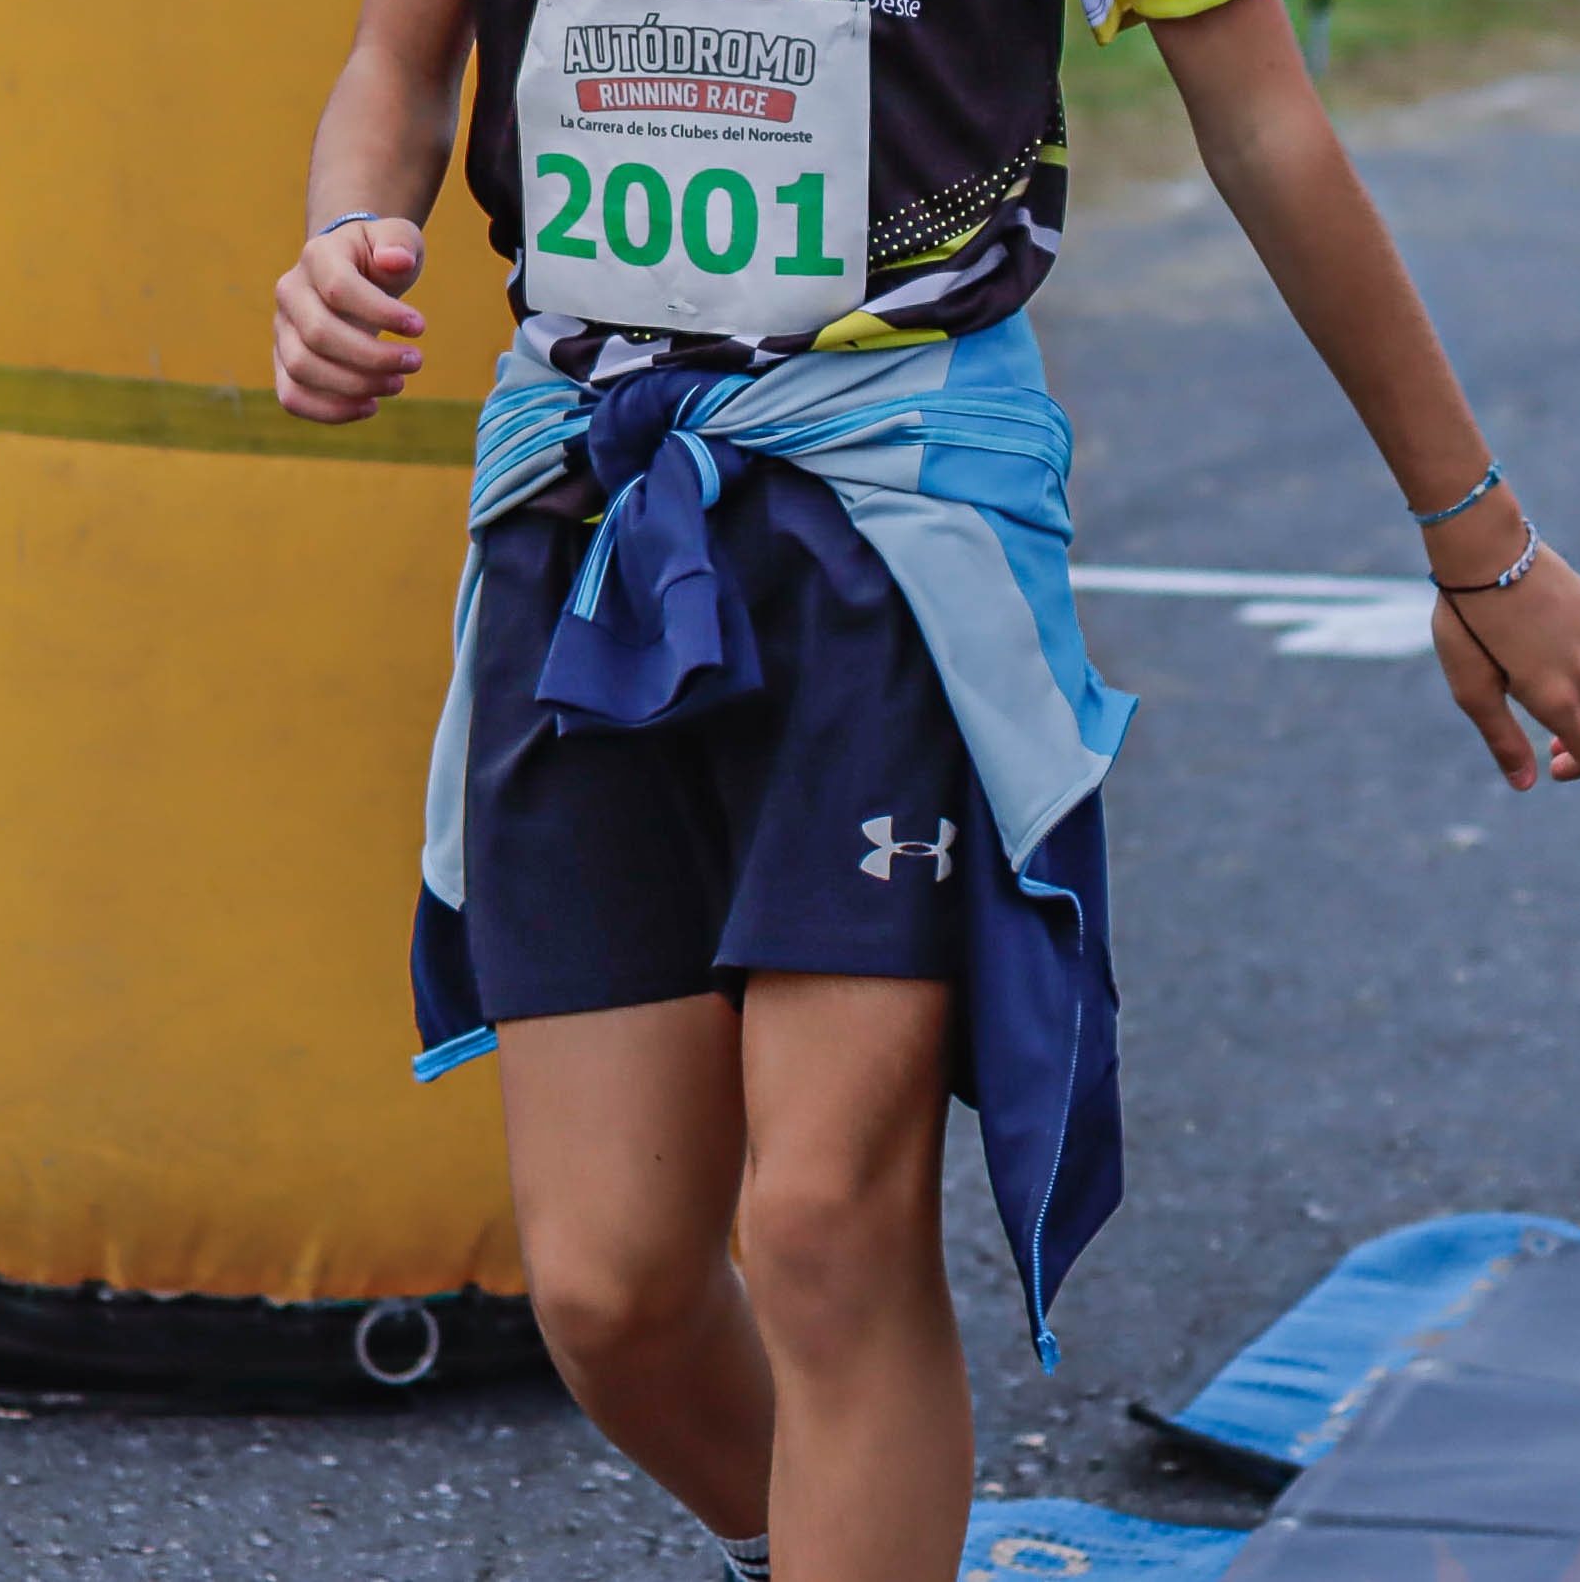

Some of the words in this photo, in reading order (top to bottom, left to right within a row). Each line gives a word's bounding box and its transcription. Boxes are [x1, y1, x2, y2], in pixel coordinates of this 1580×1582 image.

[563, 12, 816, 86] AUTÓDROMO
[598, 81, 698, 109] RUNNING
[706, 84, 769, 116] RACE
[560, 114, 574, 128] La
[577, 117, 623, 134] Carrera
[627, 121, 644, 136] de
[647, 122, 667, 137] los
[671, 124, 718, 140] Clubes
[722, 126, 744, 141] del
[749, 127, 813, 143] Noroeste
[536, 153, 844, 276] 2001
